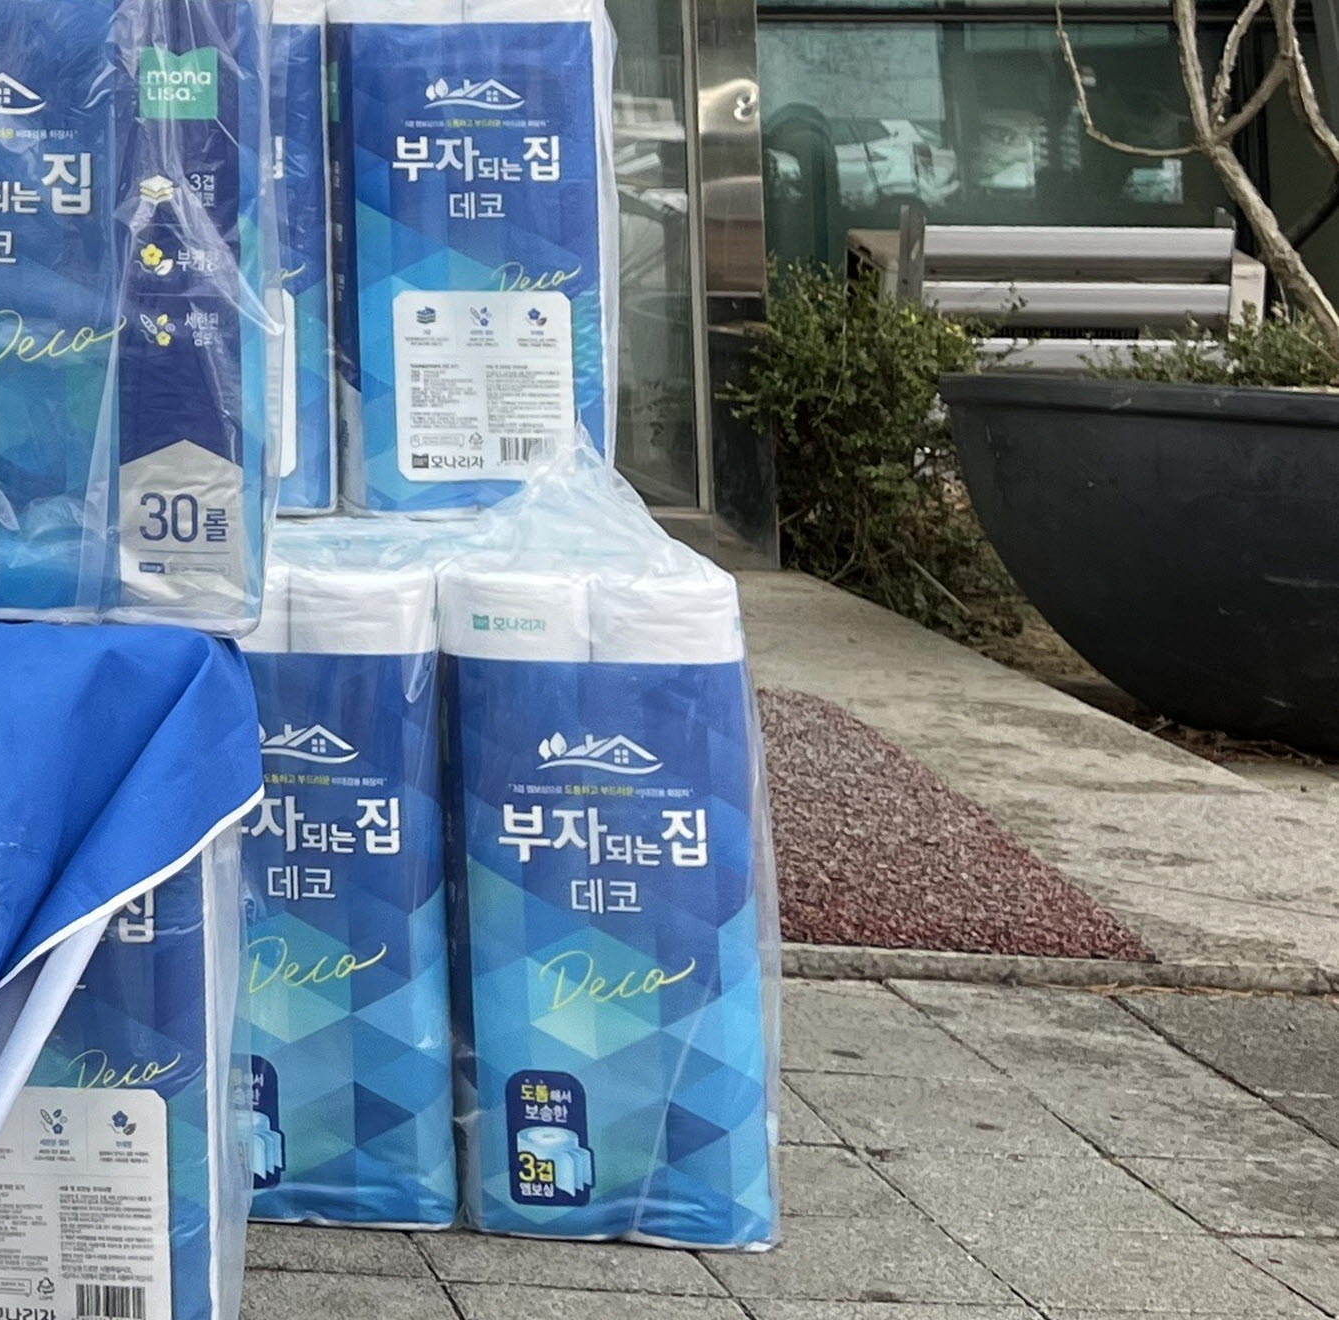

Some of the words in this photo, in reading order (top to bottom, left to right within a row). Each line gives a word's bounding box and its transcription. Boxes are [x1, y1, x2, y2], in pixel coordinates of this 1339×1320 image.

[145, 69, 212, 85] mona
[392, 135, 561, 182] 부자되는집
[189, 173, 216, 192] 3겹
[448, 192, 506, 220] 데코
[490, 262, 582, 292] Deco
[431, 455, 485, 471] 모나리자
[139, 492, 230, 544] 30롤
[492, 615, 547, 632] 모나리자
[249, 795, 401, 856] 자되는집
[498, 802, 710, 868] 부자되는집
[266, 864, 337, 903] 데코
[570, 879, 643, 916] 데코
[247, 936, 387, 996] Deco
[538, 950, 697, 1012] Deco
[524, 1104, 569, 1124] 보송한
[517, 1152, 555, 1185] 3겹
